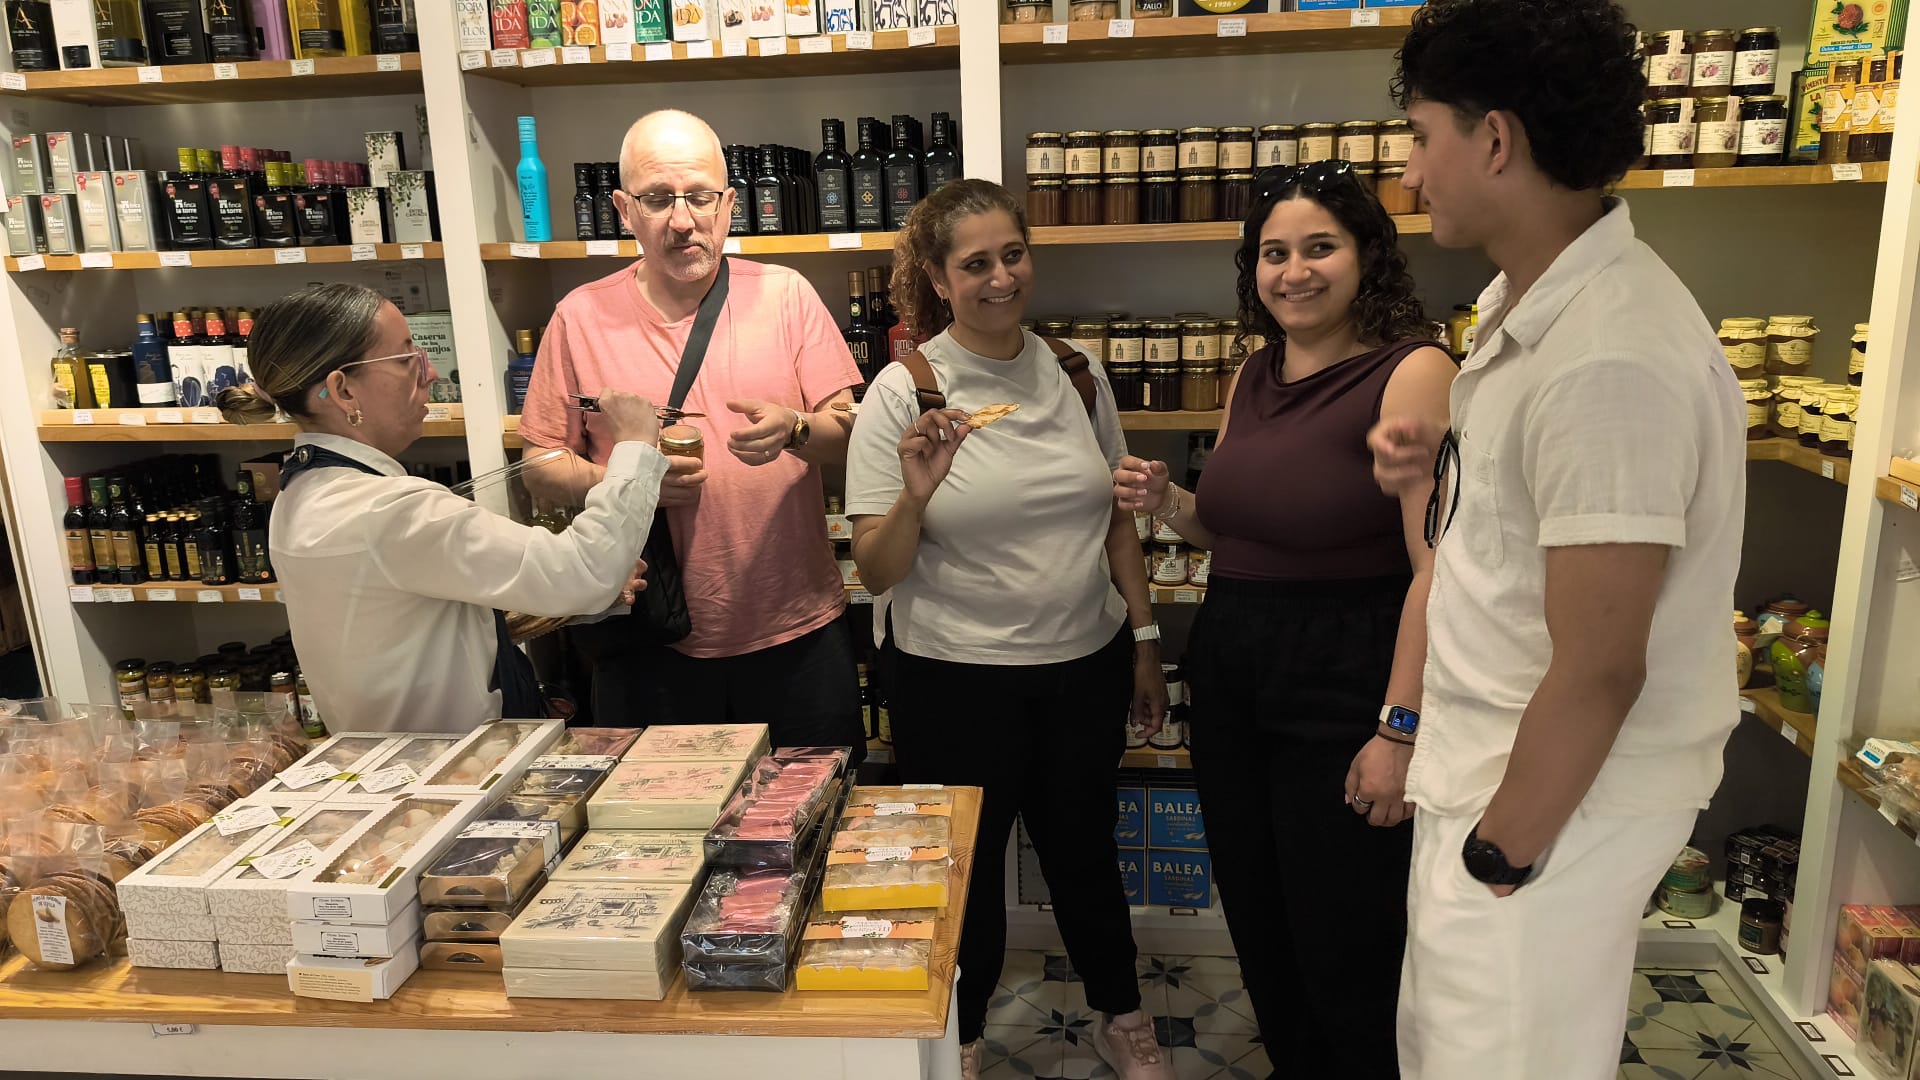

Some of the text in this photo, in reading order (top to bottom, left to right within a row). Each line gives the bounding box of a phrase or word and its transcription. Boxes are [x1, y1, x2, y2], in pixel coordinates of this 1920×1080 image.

[494, 5, 521, 18] ONA
[529, 3, 557, 16] ONA
[531, 16, 558, 29] IDA
[635, 10, 661, 24] IDA
[495, 18, 522, 31] IDA
[1810, 94, 1822, 102] LA
[1154, 801, 1202, 815] BALEA
[1153, 861, 1204, 876] BALEA
